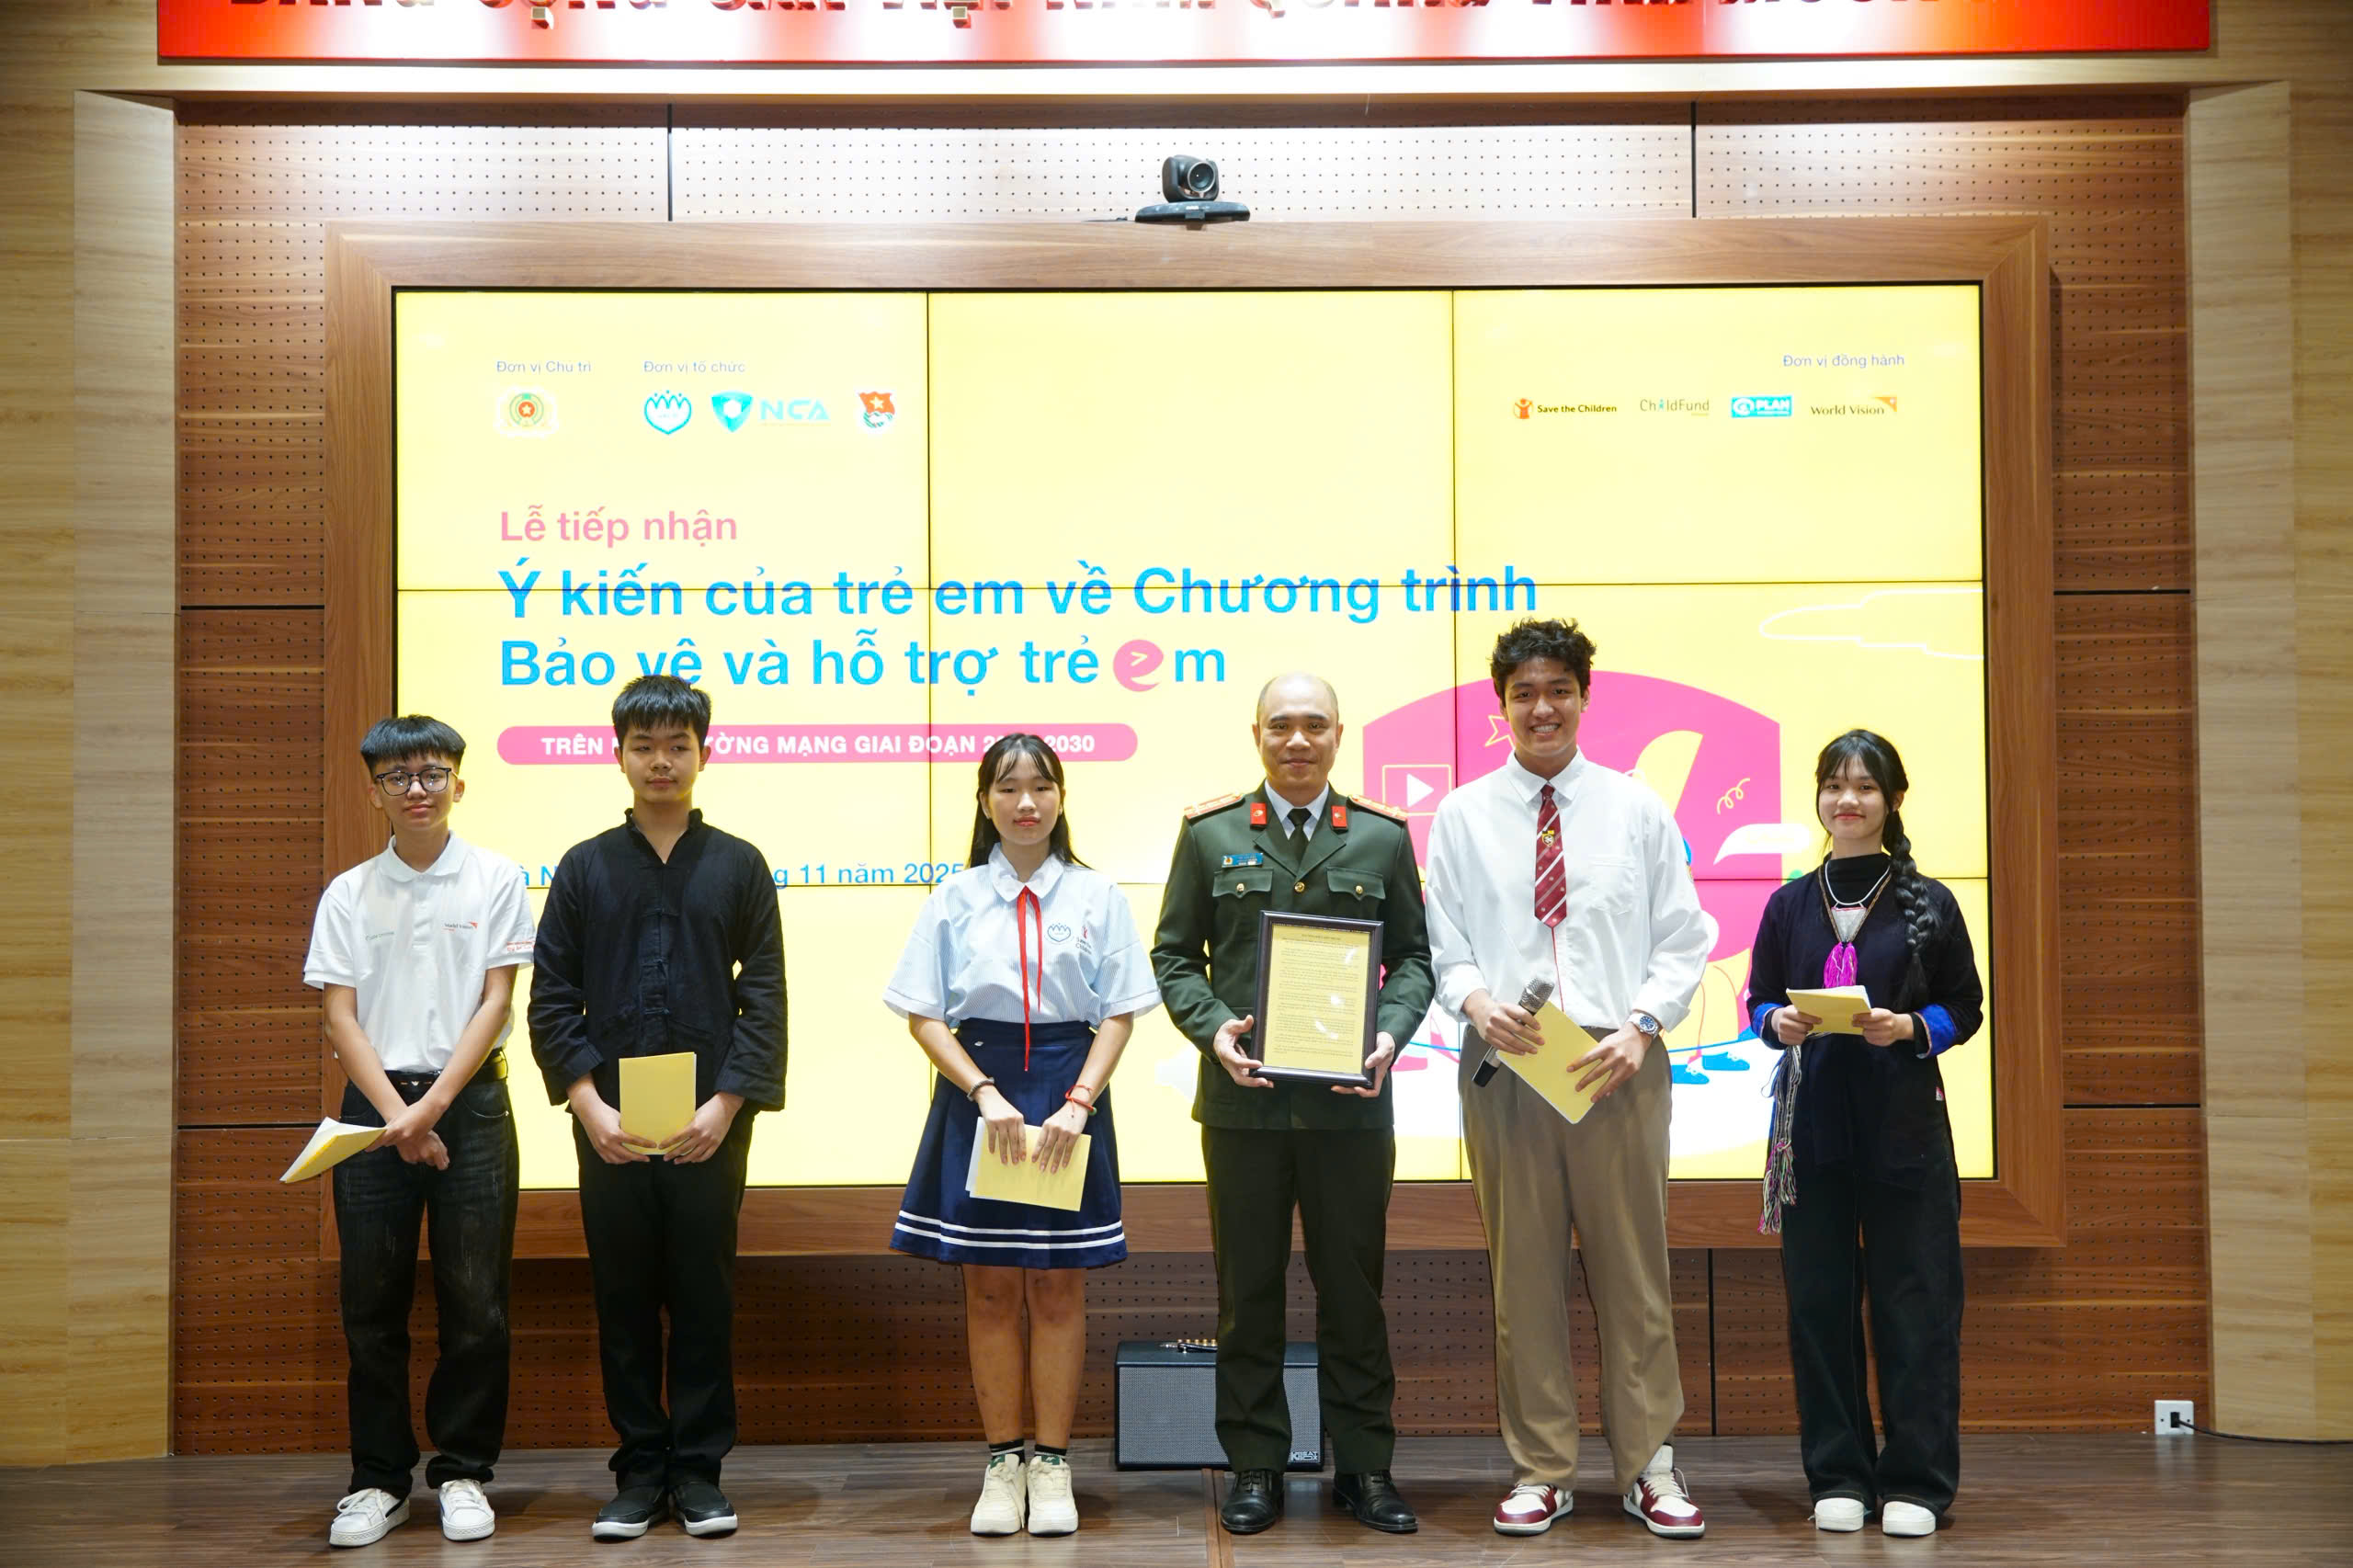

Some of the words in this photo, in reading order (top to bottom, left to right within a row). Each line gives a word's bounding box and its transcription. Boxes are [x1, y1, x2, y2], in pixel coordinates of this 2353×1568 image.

[496, 360, 526, 372] Đơn
[643, 360, 673, 372] Đơn
[1782, 354, 1812, 367] Đơn
[1832, 353, 1867, 369] đồng
[1871, 354, 1904, 367] hành
[759, 399, 832, 420] NCA
[1537, 404, 1559, 413] Save
[1561, 404, 1575, 413] the
[1577, 403, 1618, 413] Children
[1756, 399, 1790, 411] PLAN
[1811, 404, 1846, 415] World
[1849, 404, 1885, 415] Vision
[501, 505, 546, 541] Lễ
[557, 506, 630, 549] tiếp
[644, 509, 737, 547] nhận
[498, 556, 541, 619] Ý
[562, 562, 683, 617] kiến
[705, 565, 813, 616] của
[833, 565, 914, 616] trẻ
[934, 580, 1024, 616] em
[1046, 559, 1112, 616] về
[1133, 566, 1380, 624] Chương
[1400, 564, 1537, 612] trình
[501, 636, 616, 687] Bảo
[722, 638, 790, 686] và
[813, 628, 884, 686] hỗ
[904, 641, 999, 697] trợ
[1018, 634, 1099, 685] trẻ
[540, 733, 605, 756] TRÊN
[777, 735, 847, 757] MẠNG
[854, 734, 902, 754] GIAI
[908, 734, 975, 756] ĐOẠN
[800, 863, 825, 883] 11
[837, 862, 894, 883] năm
